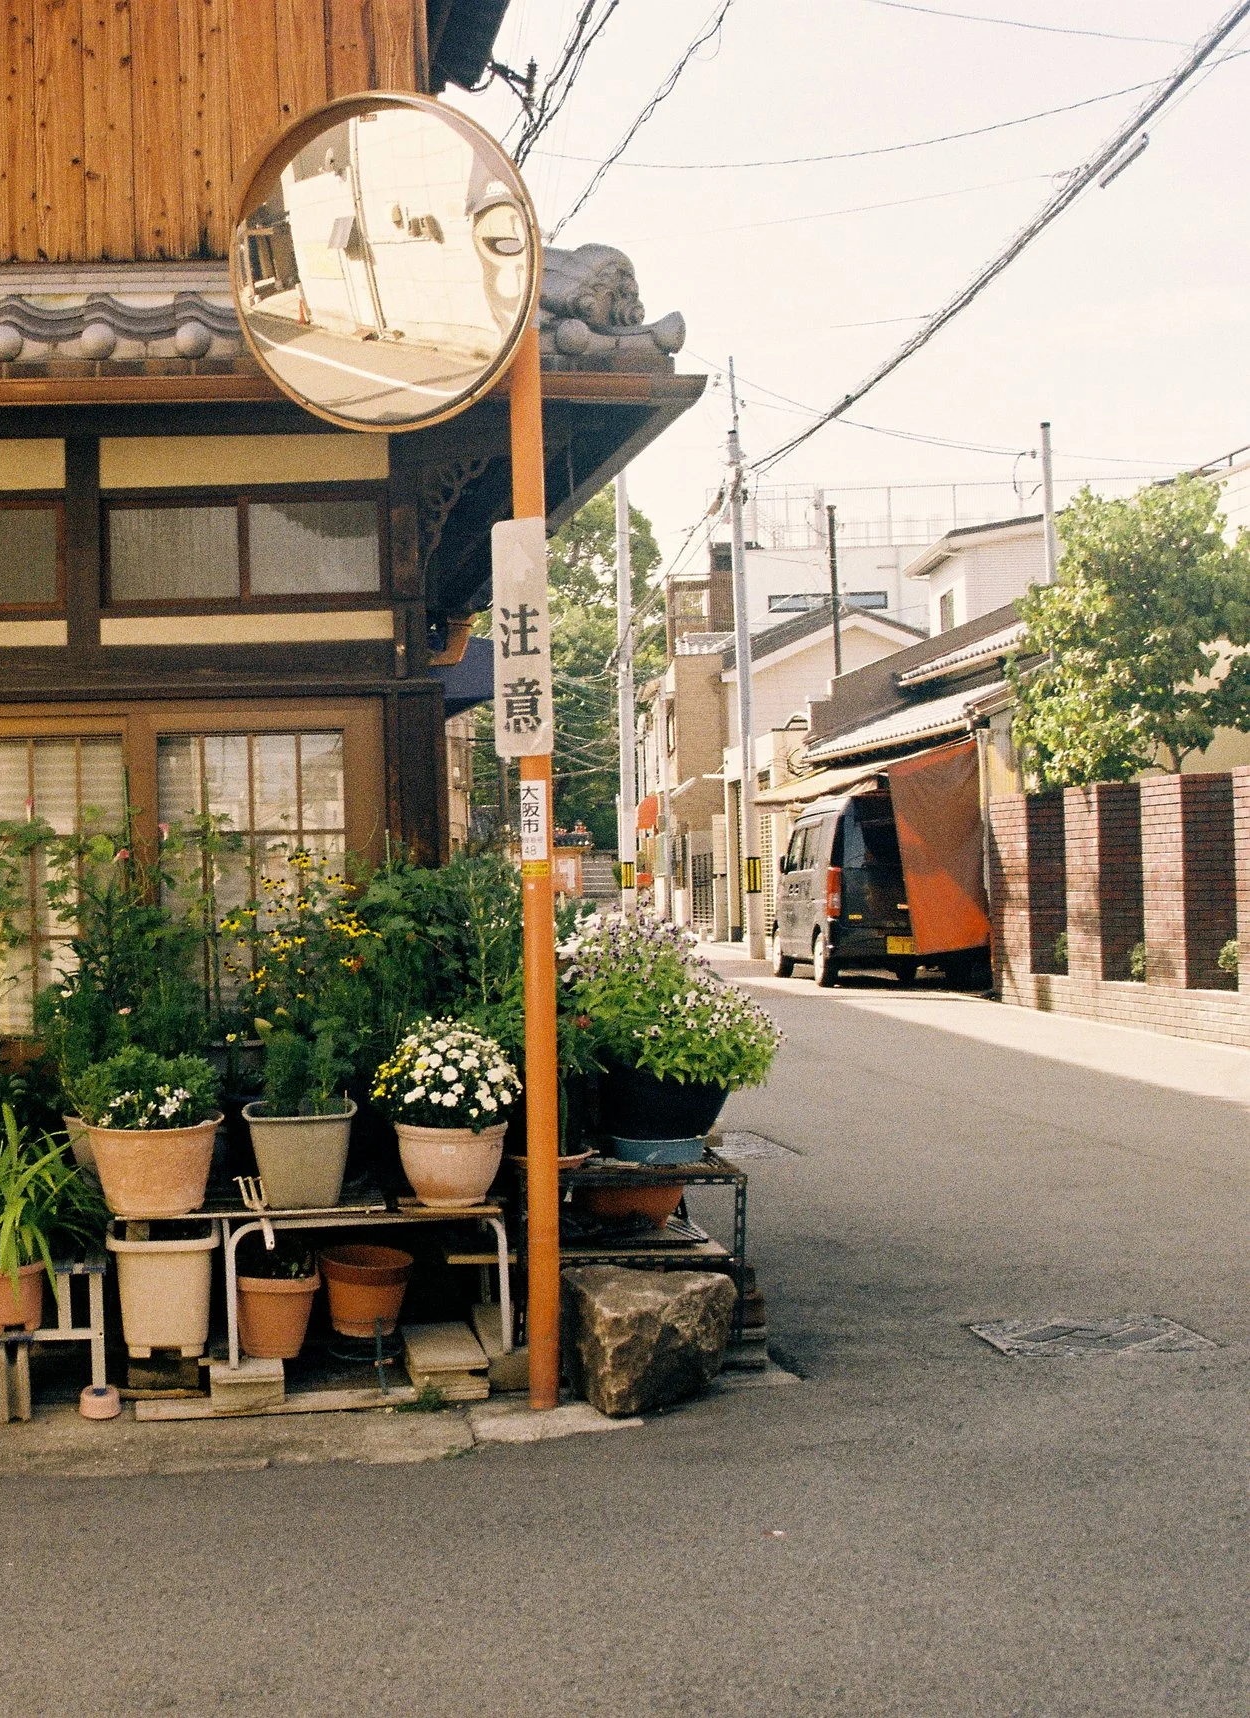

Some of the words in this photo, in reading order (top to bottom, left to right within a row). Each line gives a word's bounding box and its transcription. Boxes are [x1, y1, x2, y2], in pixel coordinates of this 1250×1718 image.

[499, 603, 542, 734] 注意
[521, 785, 540, 834] 大阪市
